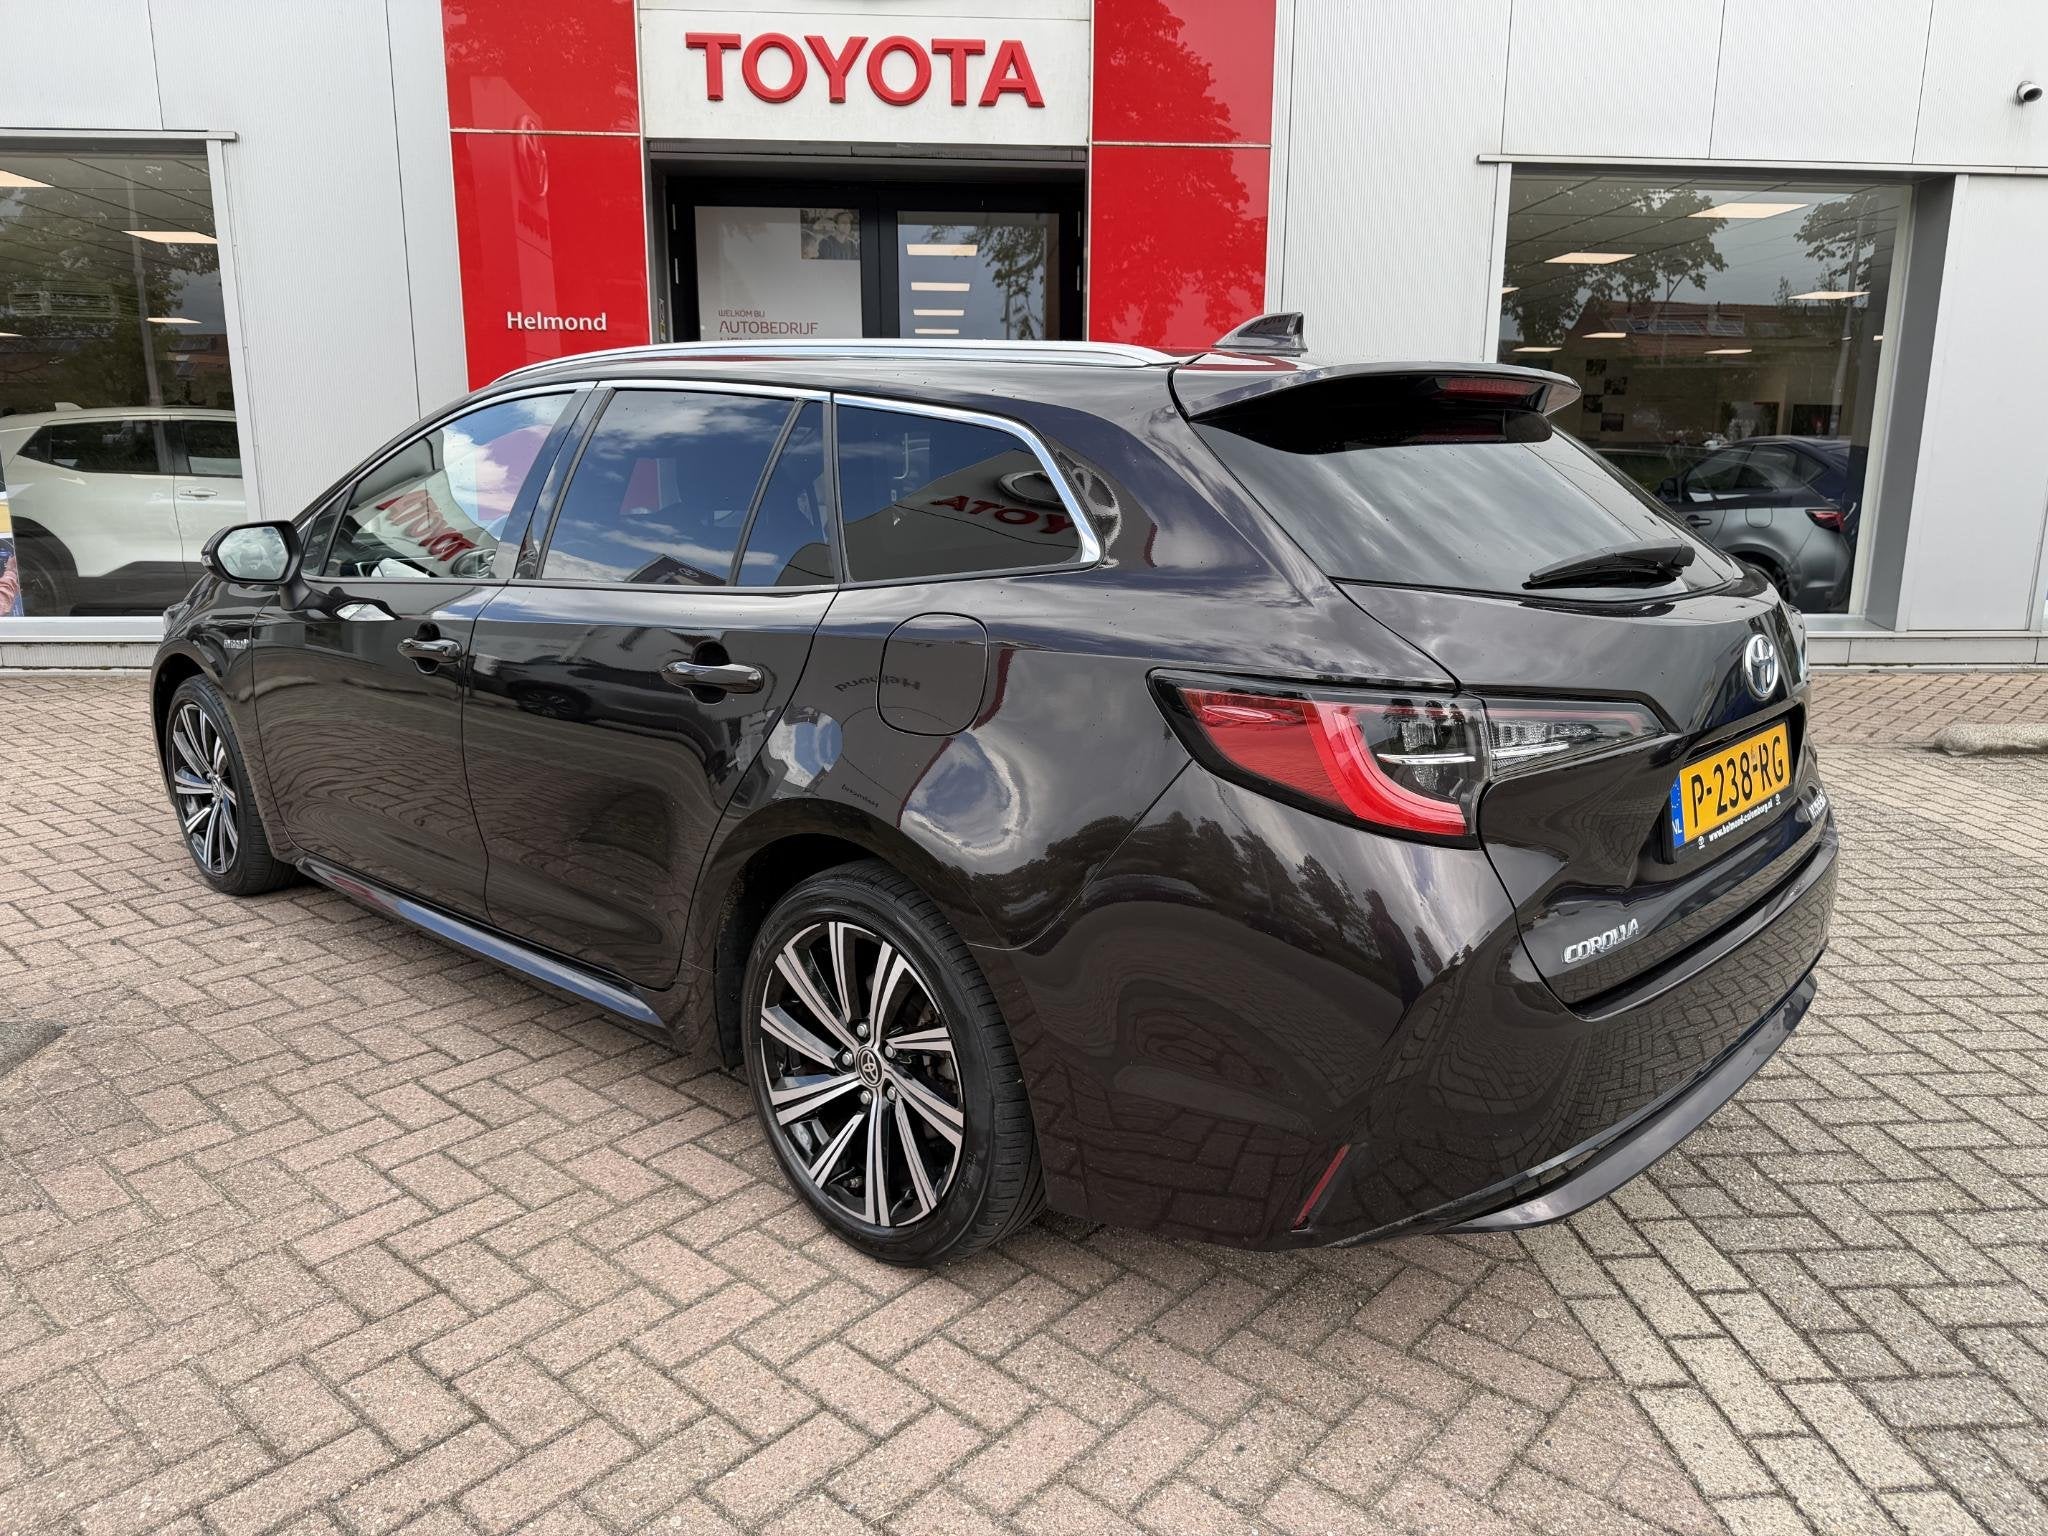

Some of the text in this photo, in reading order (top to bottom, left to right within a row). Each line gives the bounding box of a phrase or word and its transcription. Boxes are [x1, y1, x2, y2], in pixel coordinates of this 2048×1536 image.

[685, 32, 1045, 108] TOYOTA
[506, 311, 607, 331] Helmond
[718, 310, 753, 318] WELKOM
[719, 321, 819, 335] AUTOBEDRIJF
[1691, 735, 1784, 828] P-238-RG
[1671, 819, 1683, 835] NL
[1561, 918, 1640, 964] COROLLA
